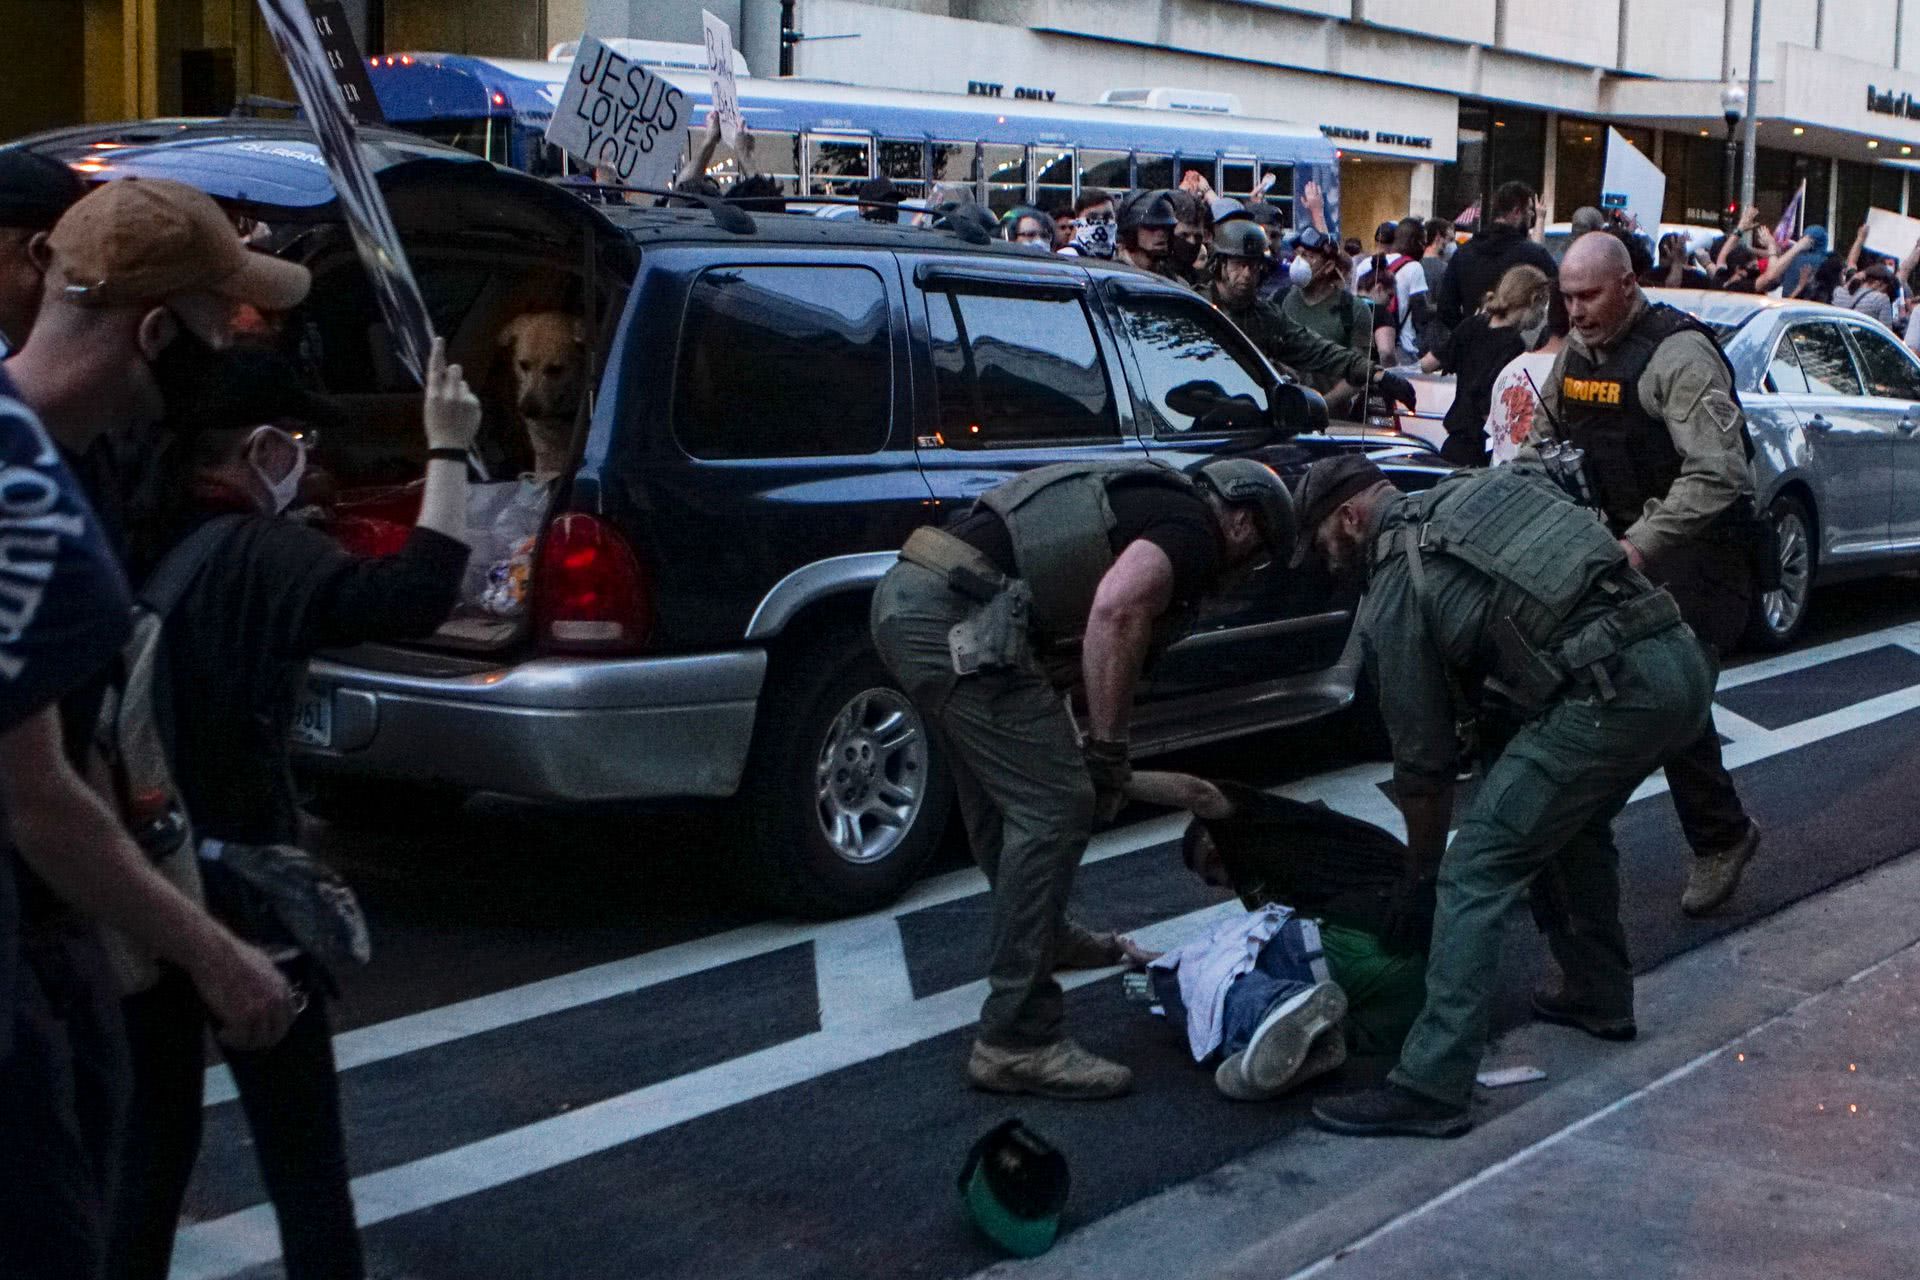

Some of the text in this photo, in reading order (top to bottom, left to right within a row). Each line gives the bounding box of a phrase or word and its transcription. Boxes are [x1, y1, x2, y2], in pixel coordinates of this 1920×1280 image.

[580, 46, 683, 131] JESUS
[968, 80, 1056, 102] EXIT ONLY
[577, 88, 659, 153] LOVES
[1319, 124, 1432, 149] PARKING ENTRANCE
[584, 125, 638, 179] YOU
